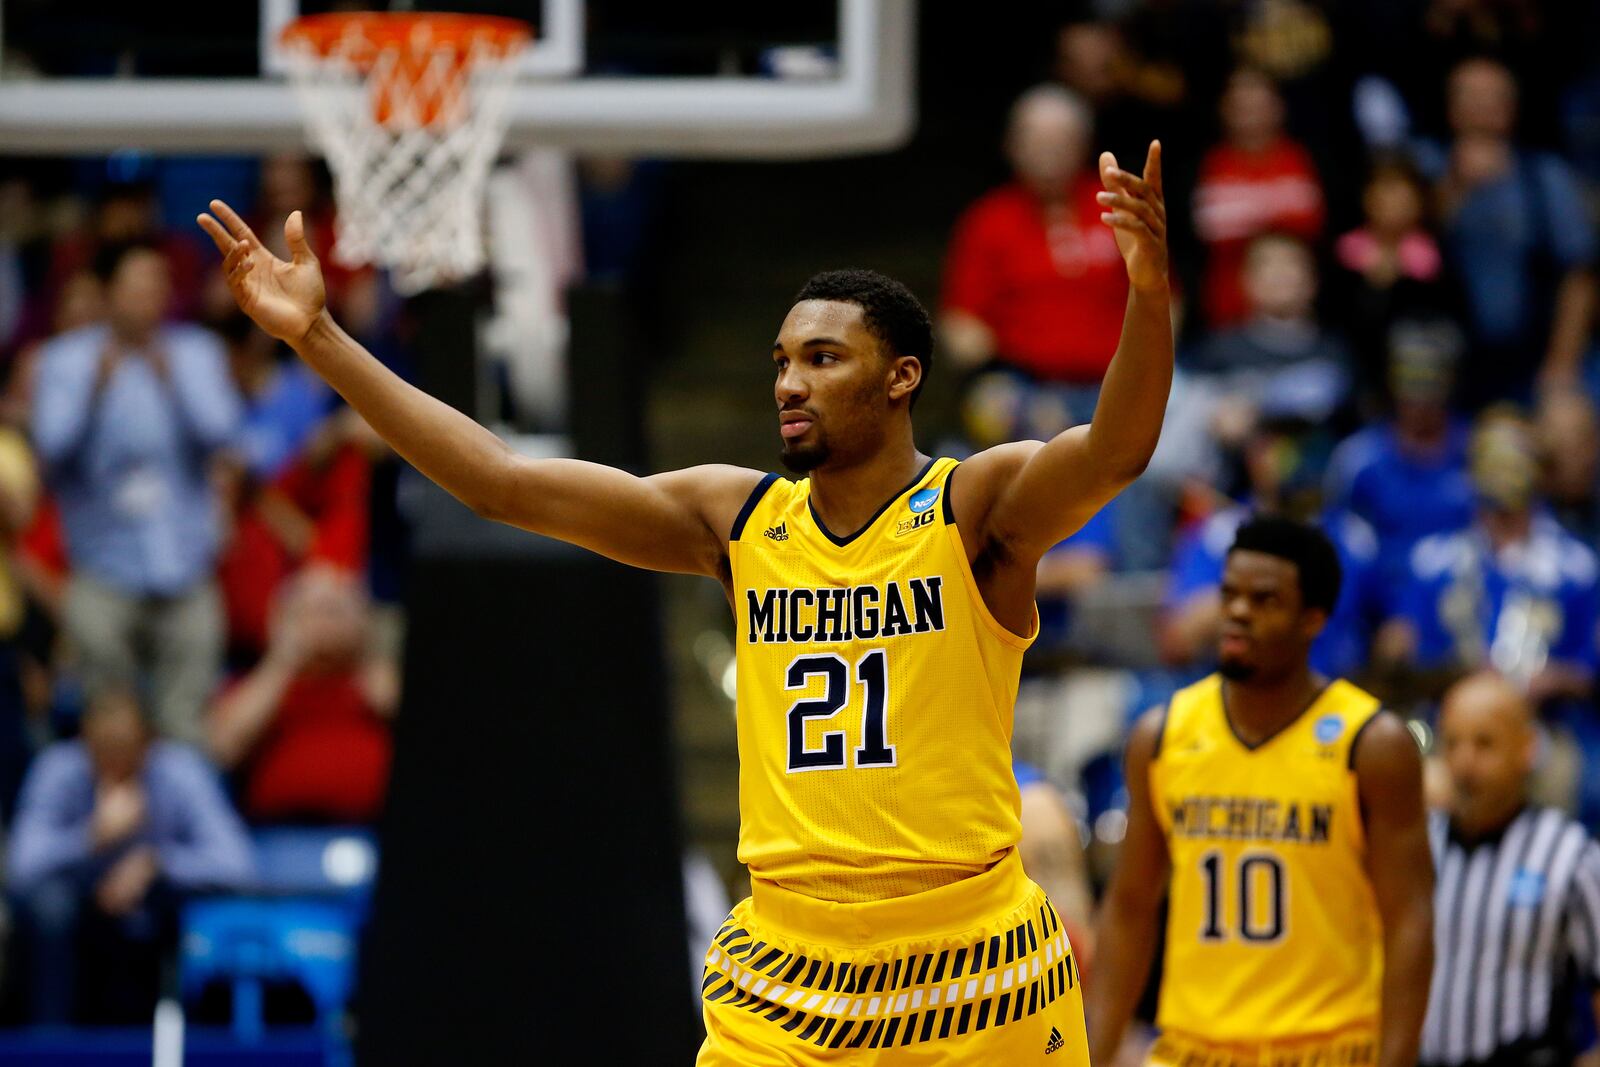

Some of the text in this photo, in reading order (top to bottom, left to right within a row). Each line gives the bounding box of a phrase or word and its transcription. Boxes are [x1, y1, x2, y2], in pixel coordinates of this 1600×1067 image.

[747, 576, 946, 644] MICHIGAN
[784, 648, 897, 774] 21
[1171, 795, 1334, 844] MICHIGAN
[1200, 850, 1287, 944] 10
